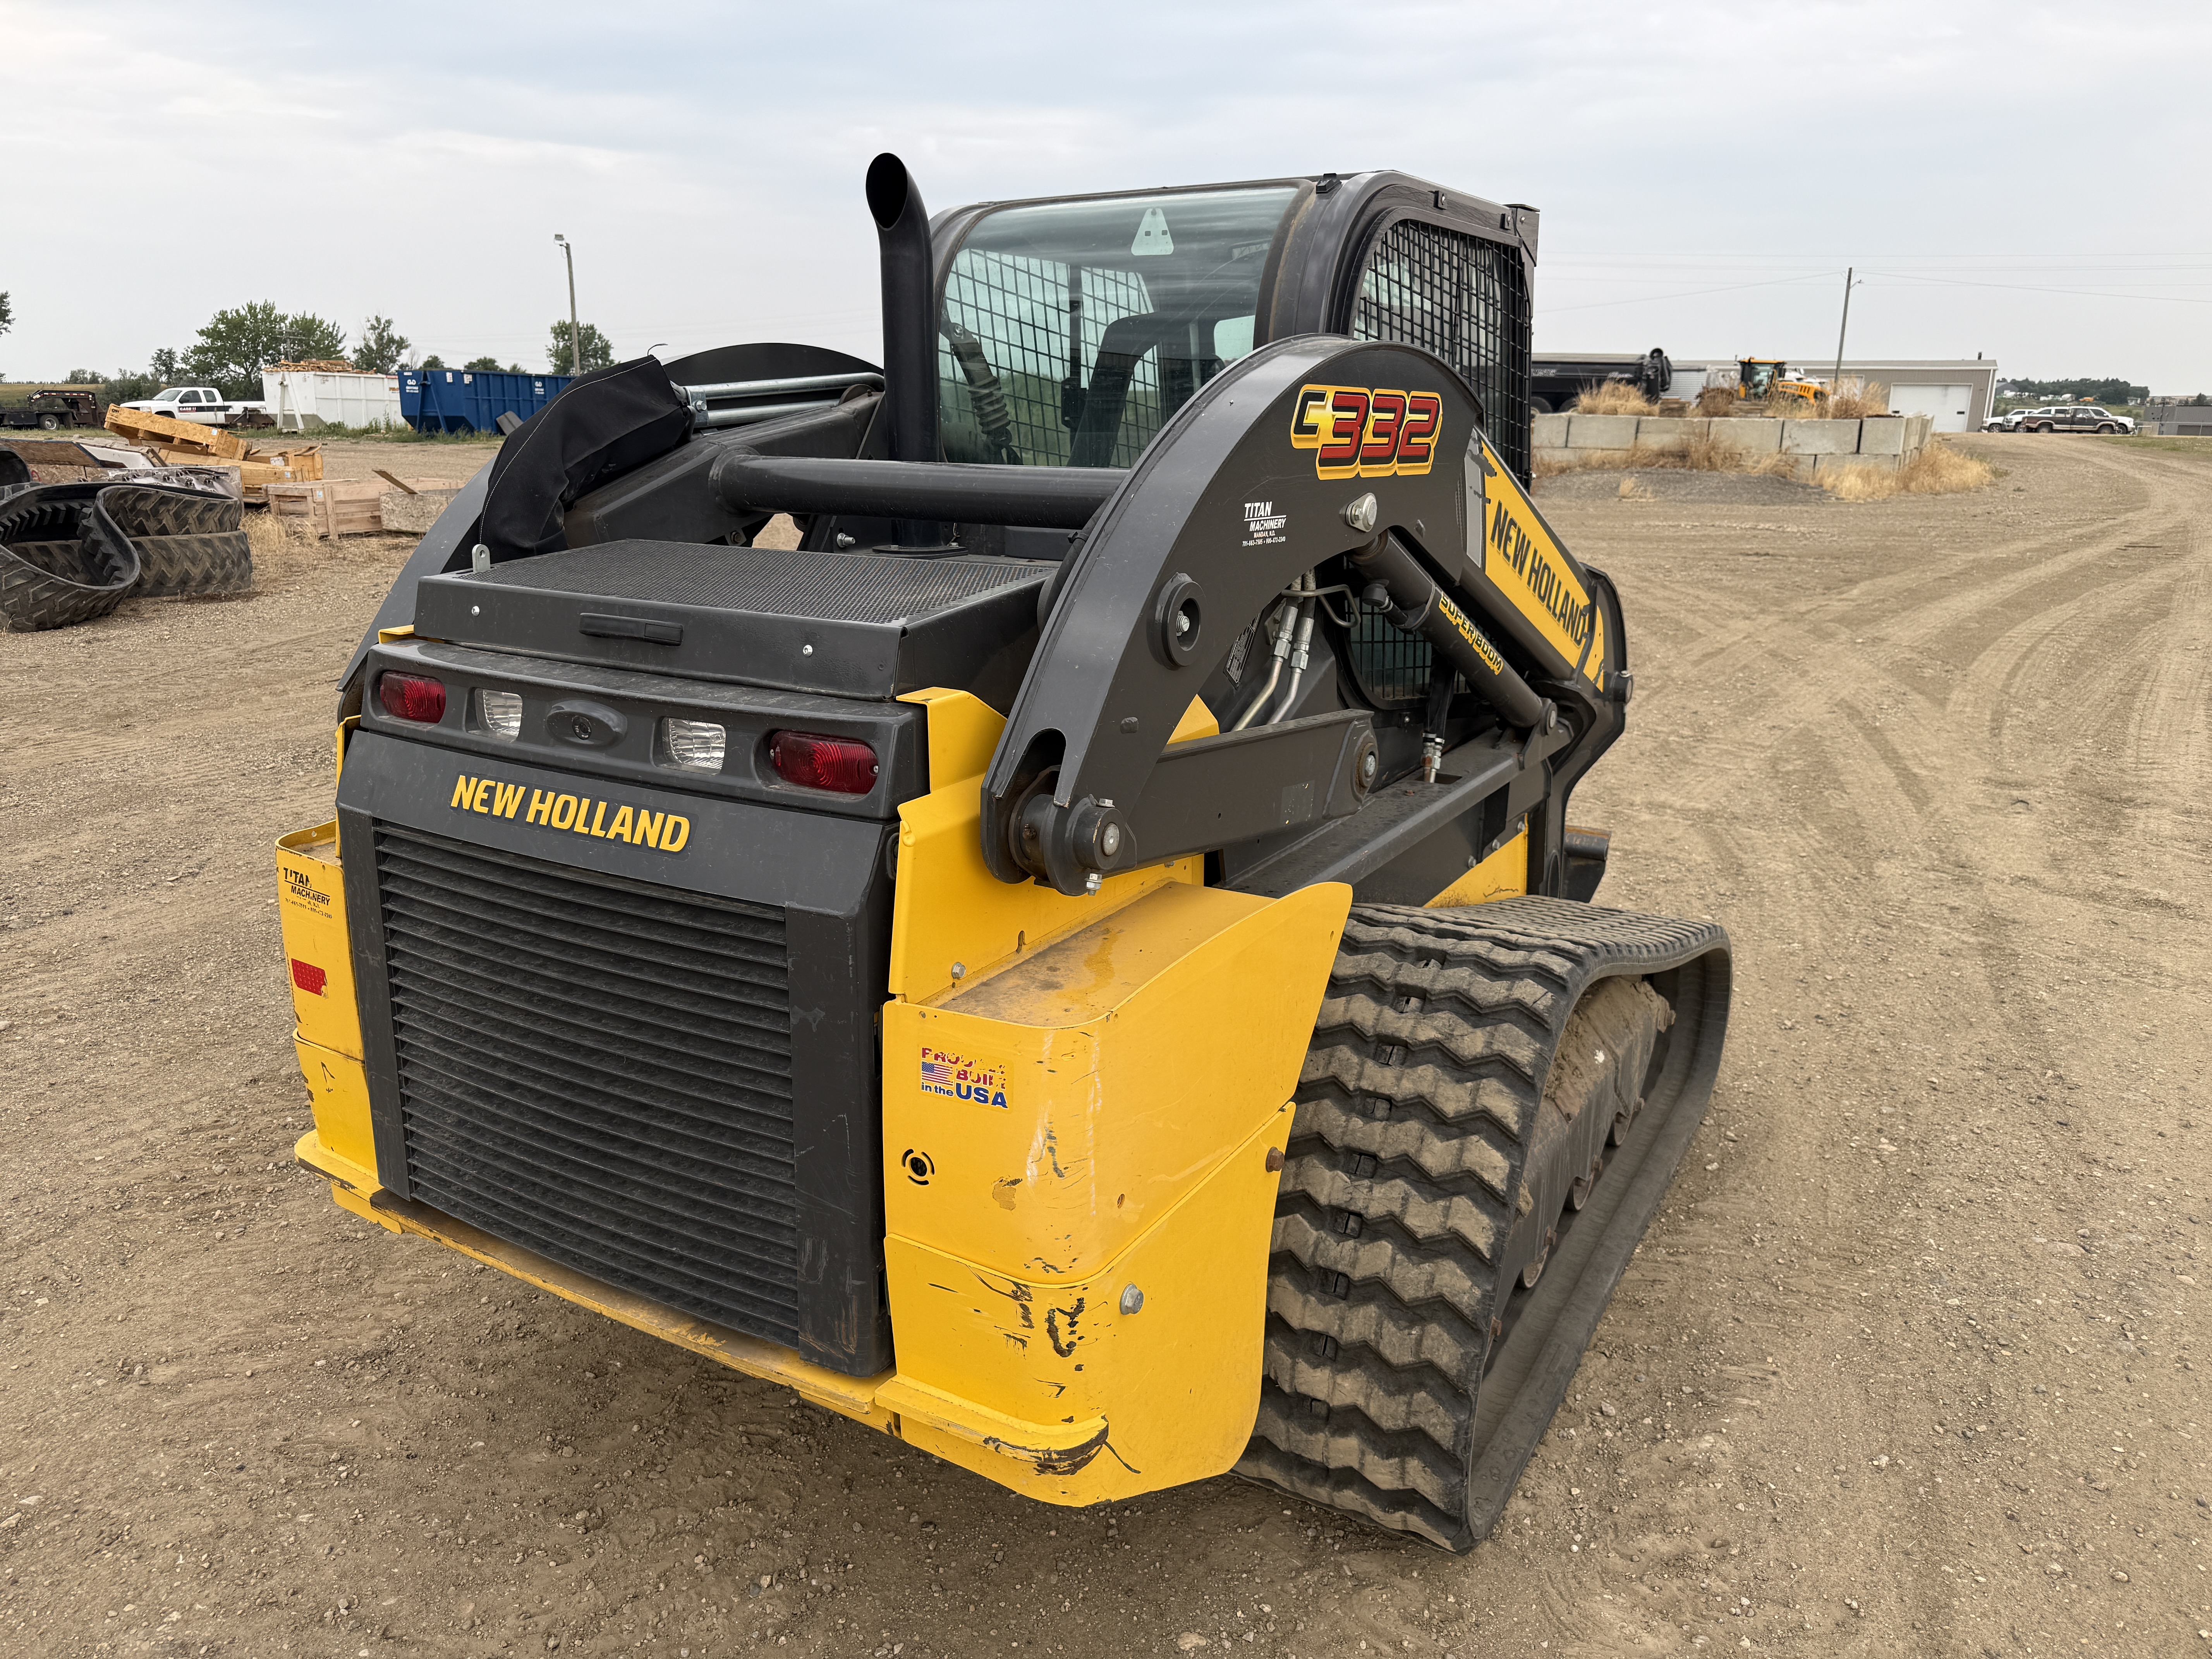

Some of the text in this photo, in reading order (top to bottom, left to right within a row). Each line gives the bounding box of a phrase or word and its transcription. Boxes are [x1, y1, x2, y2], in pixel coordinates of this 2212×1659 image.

[1244, 501, 1273, 518] TITAN
[1249, 518, 1286, 532] MACHINERY
[1490, 499, 1589, 647] NEW HOLLAND
[451, 775, 690, 852] NEW HOLLAND
[921, 1082, 1008, 1109] in the USA
